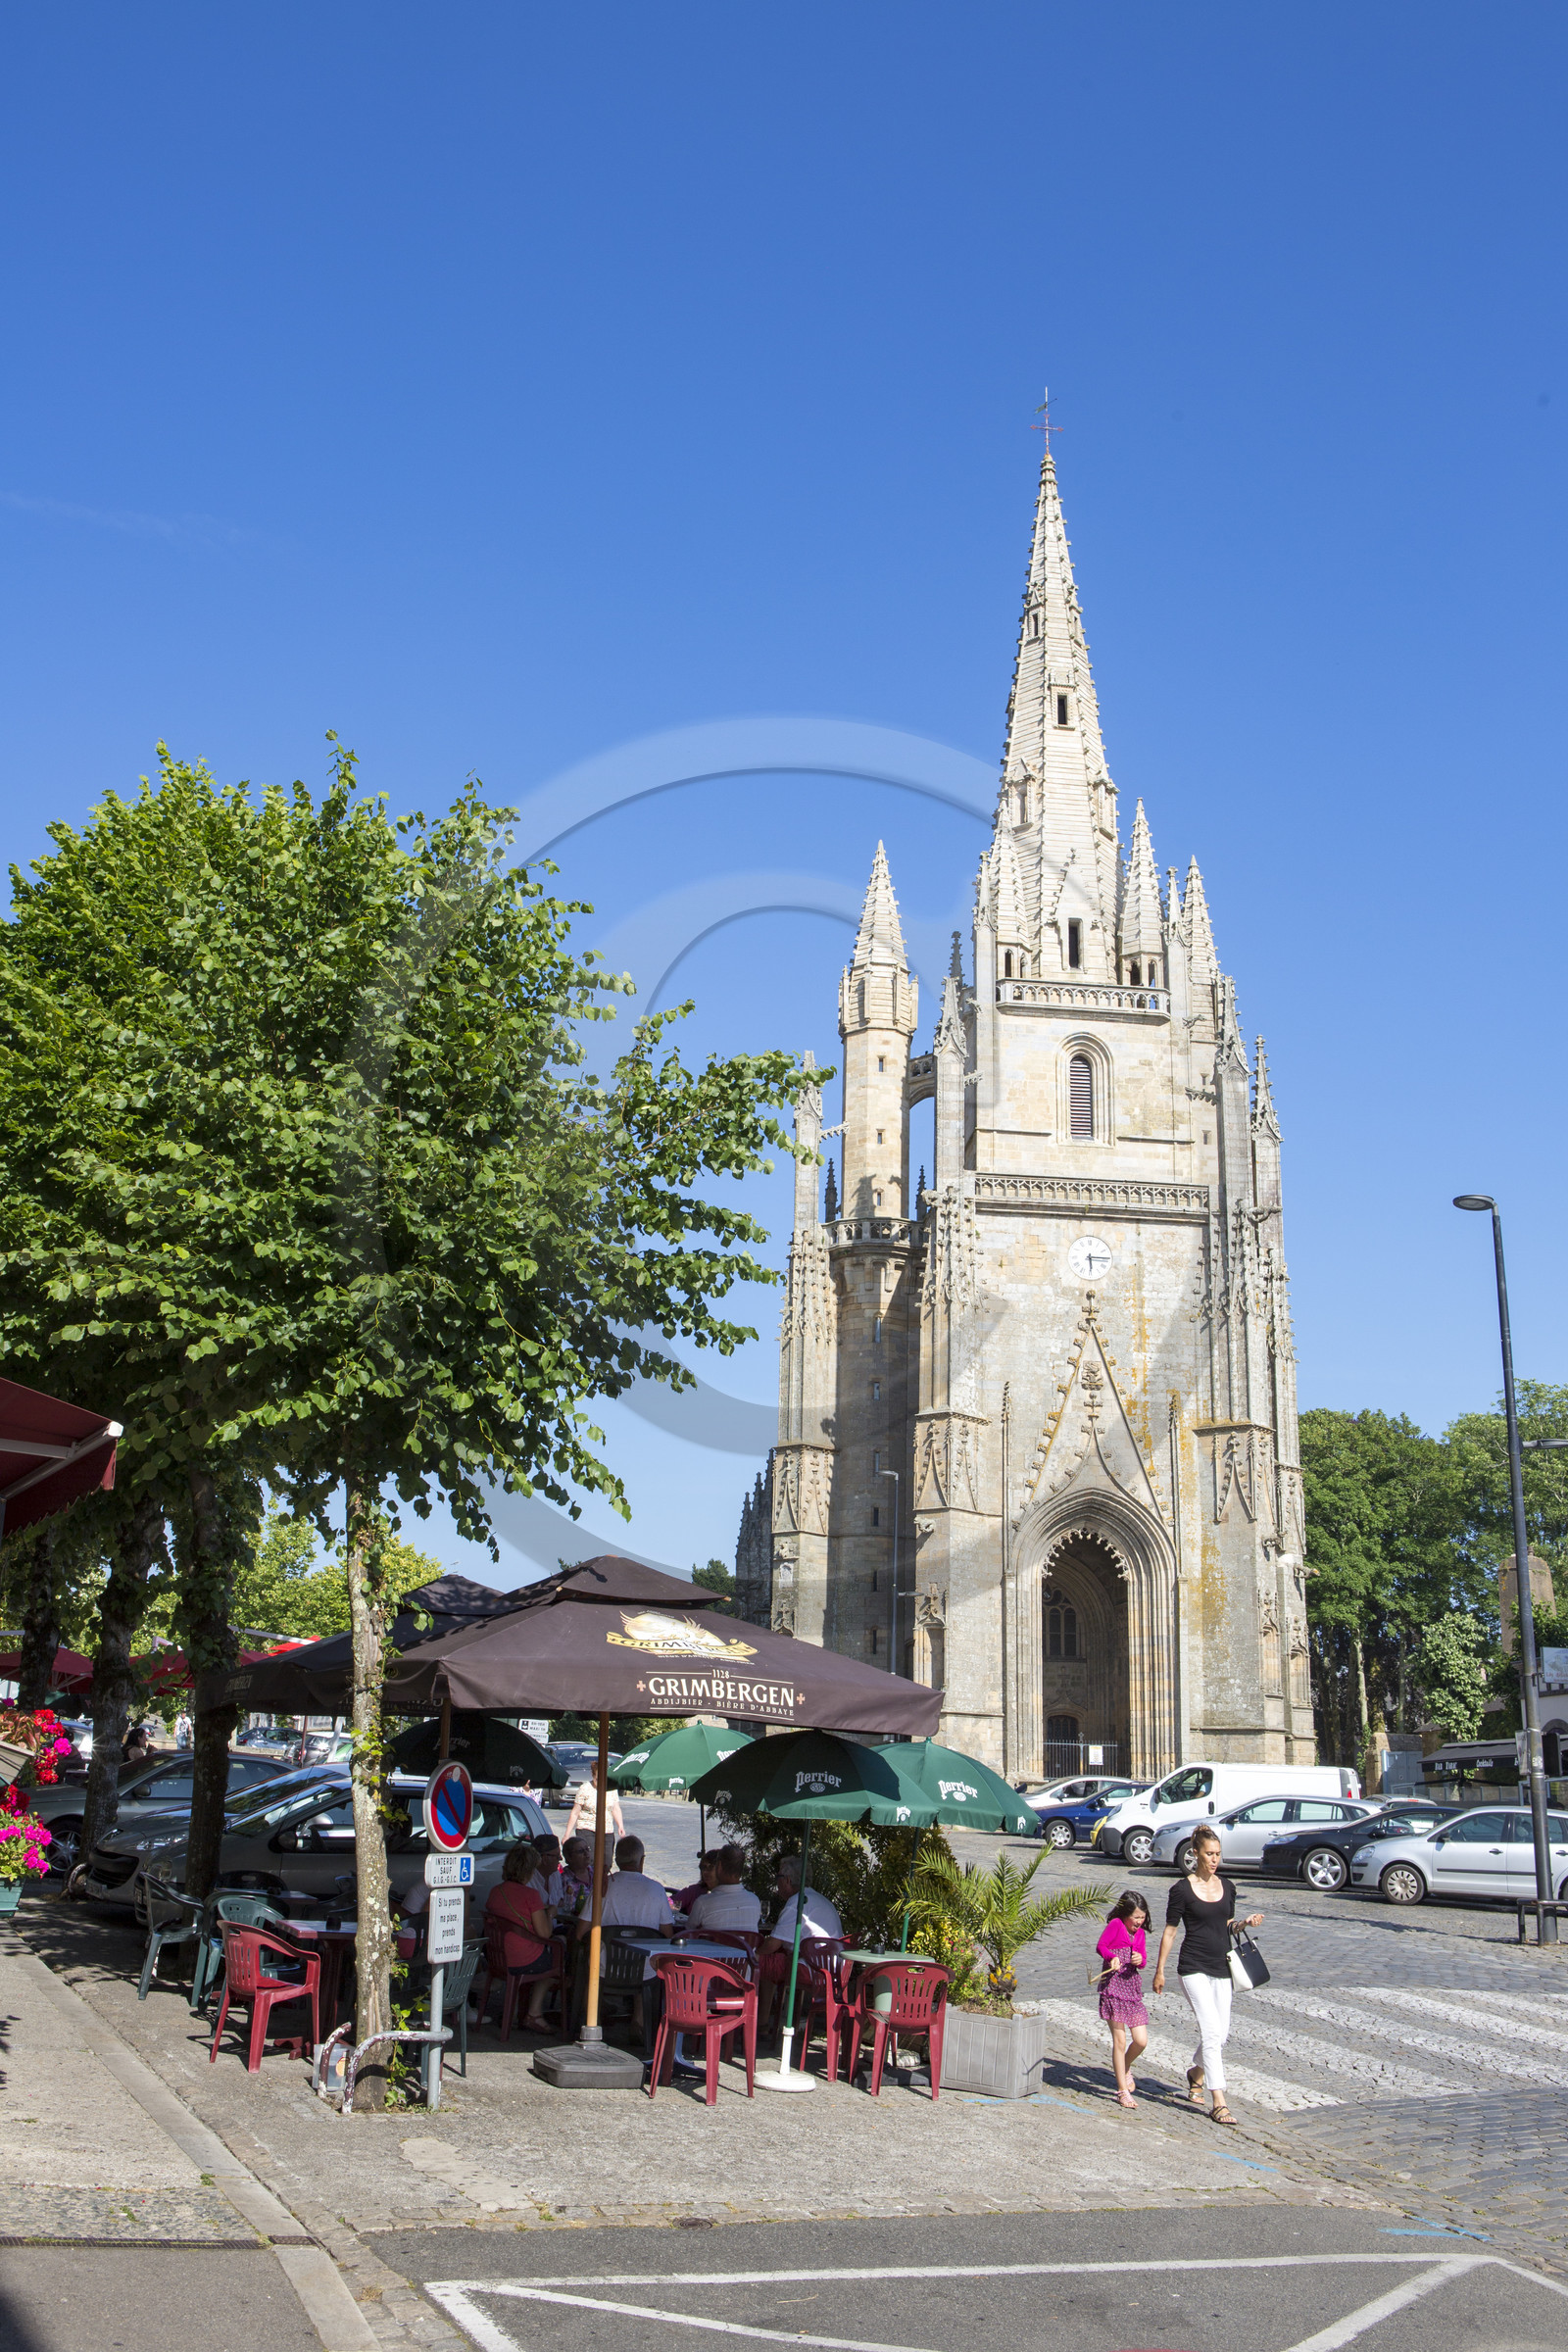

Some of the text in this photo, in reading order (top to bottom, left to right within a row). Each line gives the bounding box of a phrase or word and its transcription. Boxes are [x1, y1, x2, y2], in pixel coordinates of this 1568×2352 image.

[711, 1669, 730, 1680] 1128
[648, 1677, 794, 1707] GRIMBERGEN
[651, 1697, 795, 1716] ABDIJBIER BIÈRE D'ABBAYE
[435, 1857, 458, 1866] INTERDIT
[443, 1898, 448, 1907] tu
[448, 1897, 462, 1908] prends
[442, 1928, 456, 1939] prends
